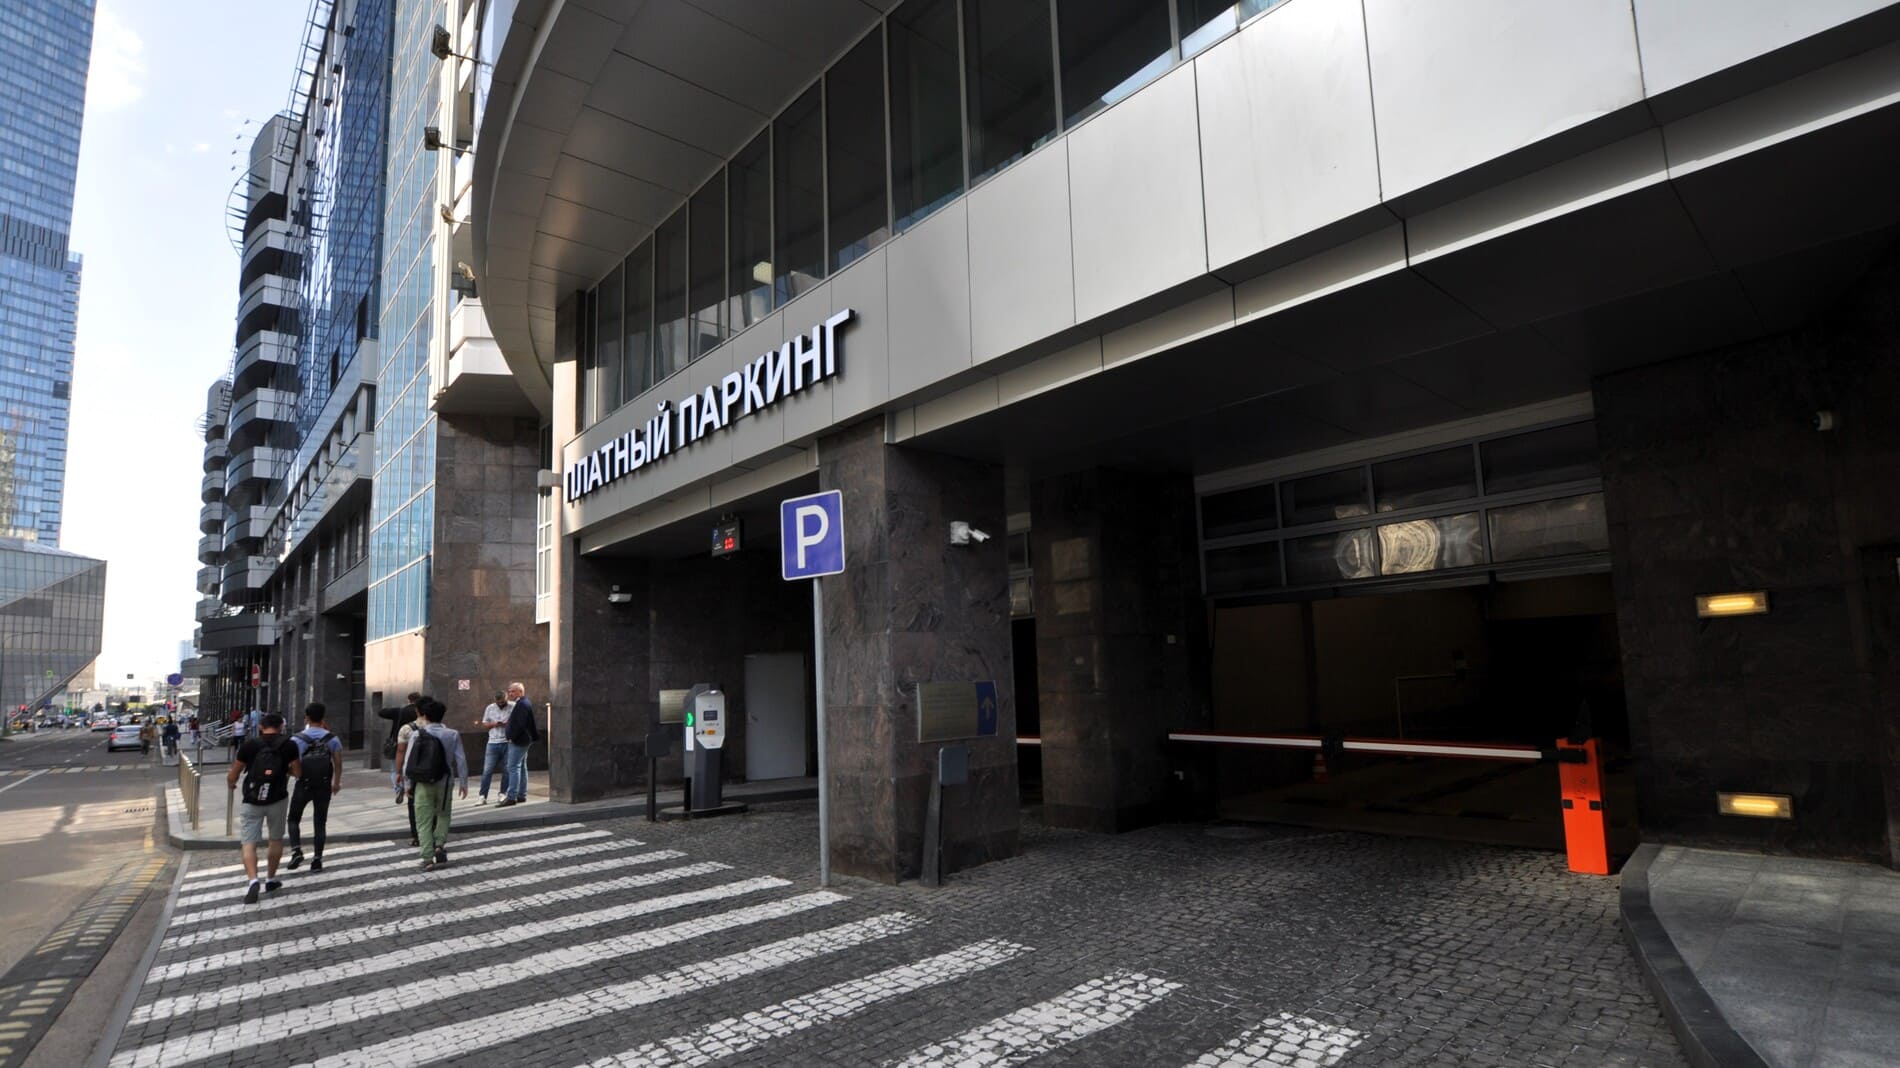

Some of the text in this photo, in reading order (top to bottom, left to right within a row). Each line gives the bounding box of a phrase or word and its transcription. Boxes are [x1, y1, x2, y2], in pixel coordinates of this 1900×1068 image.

[563, 308, 856, 503] ПЛАТНЫЙ ПАРКИНГ
[796, 505, 829, 569] P
